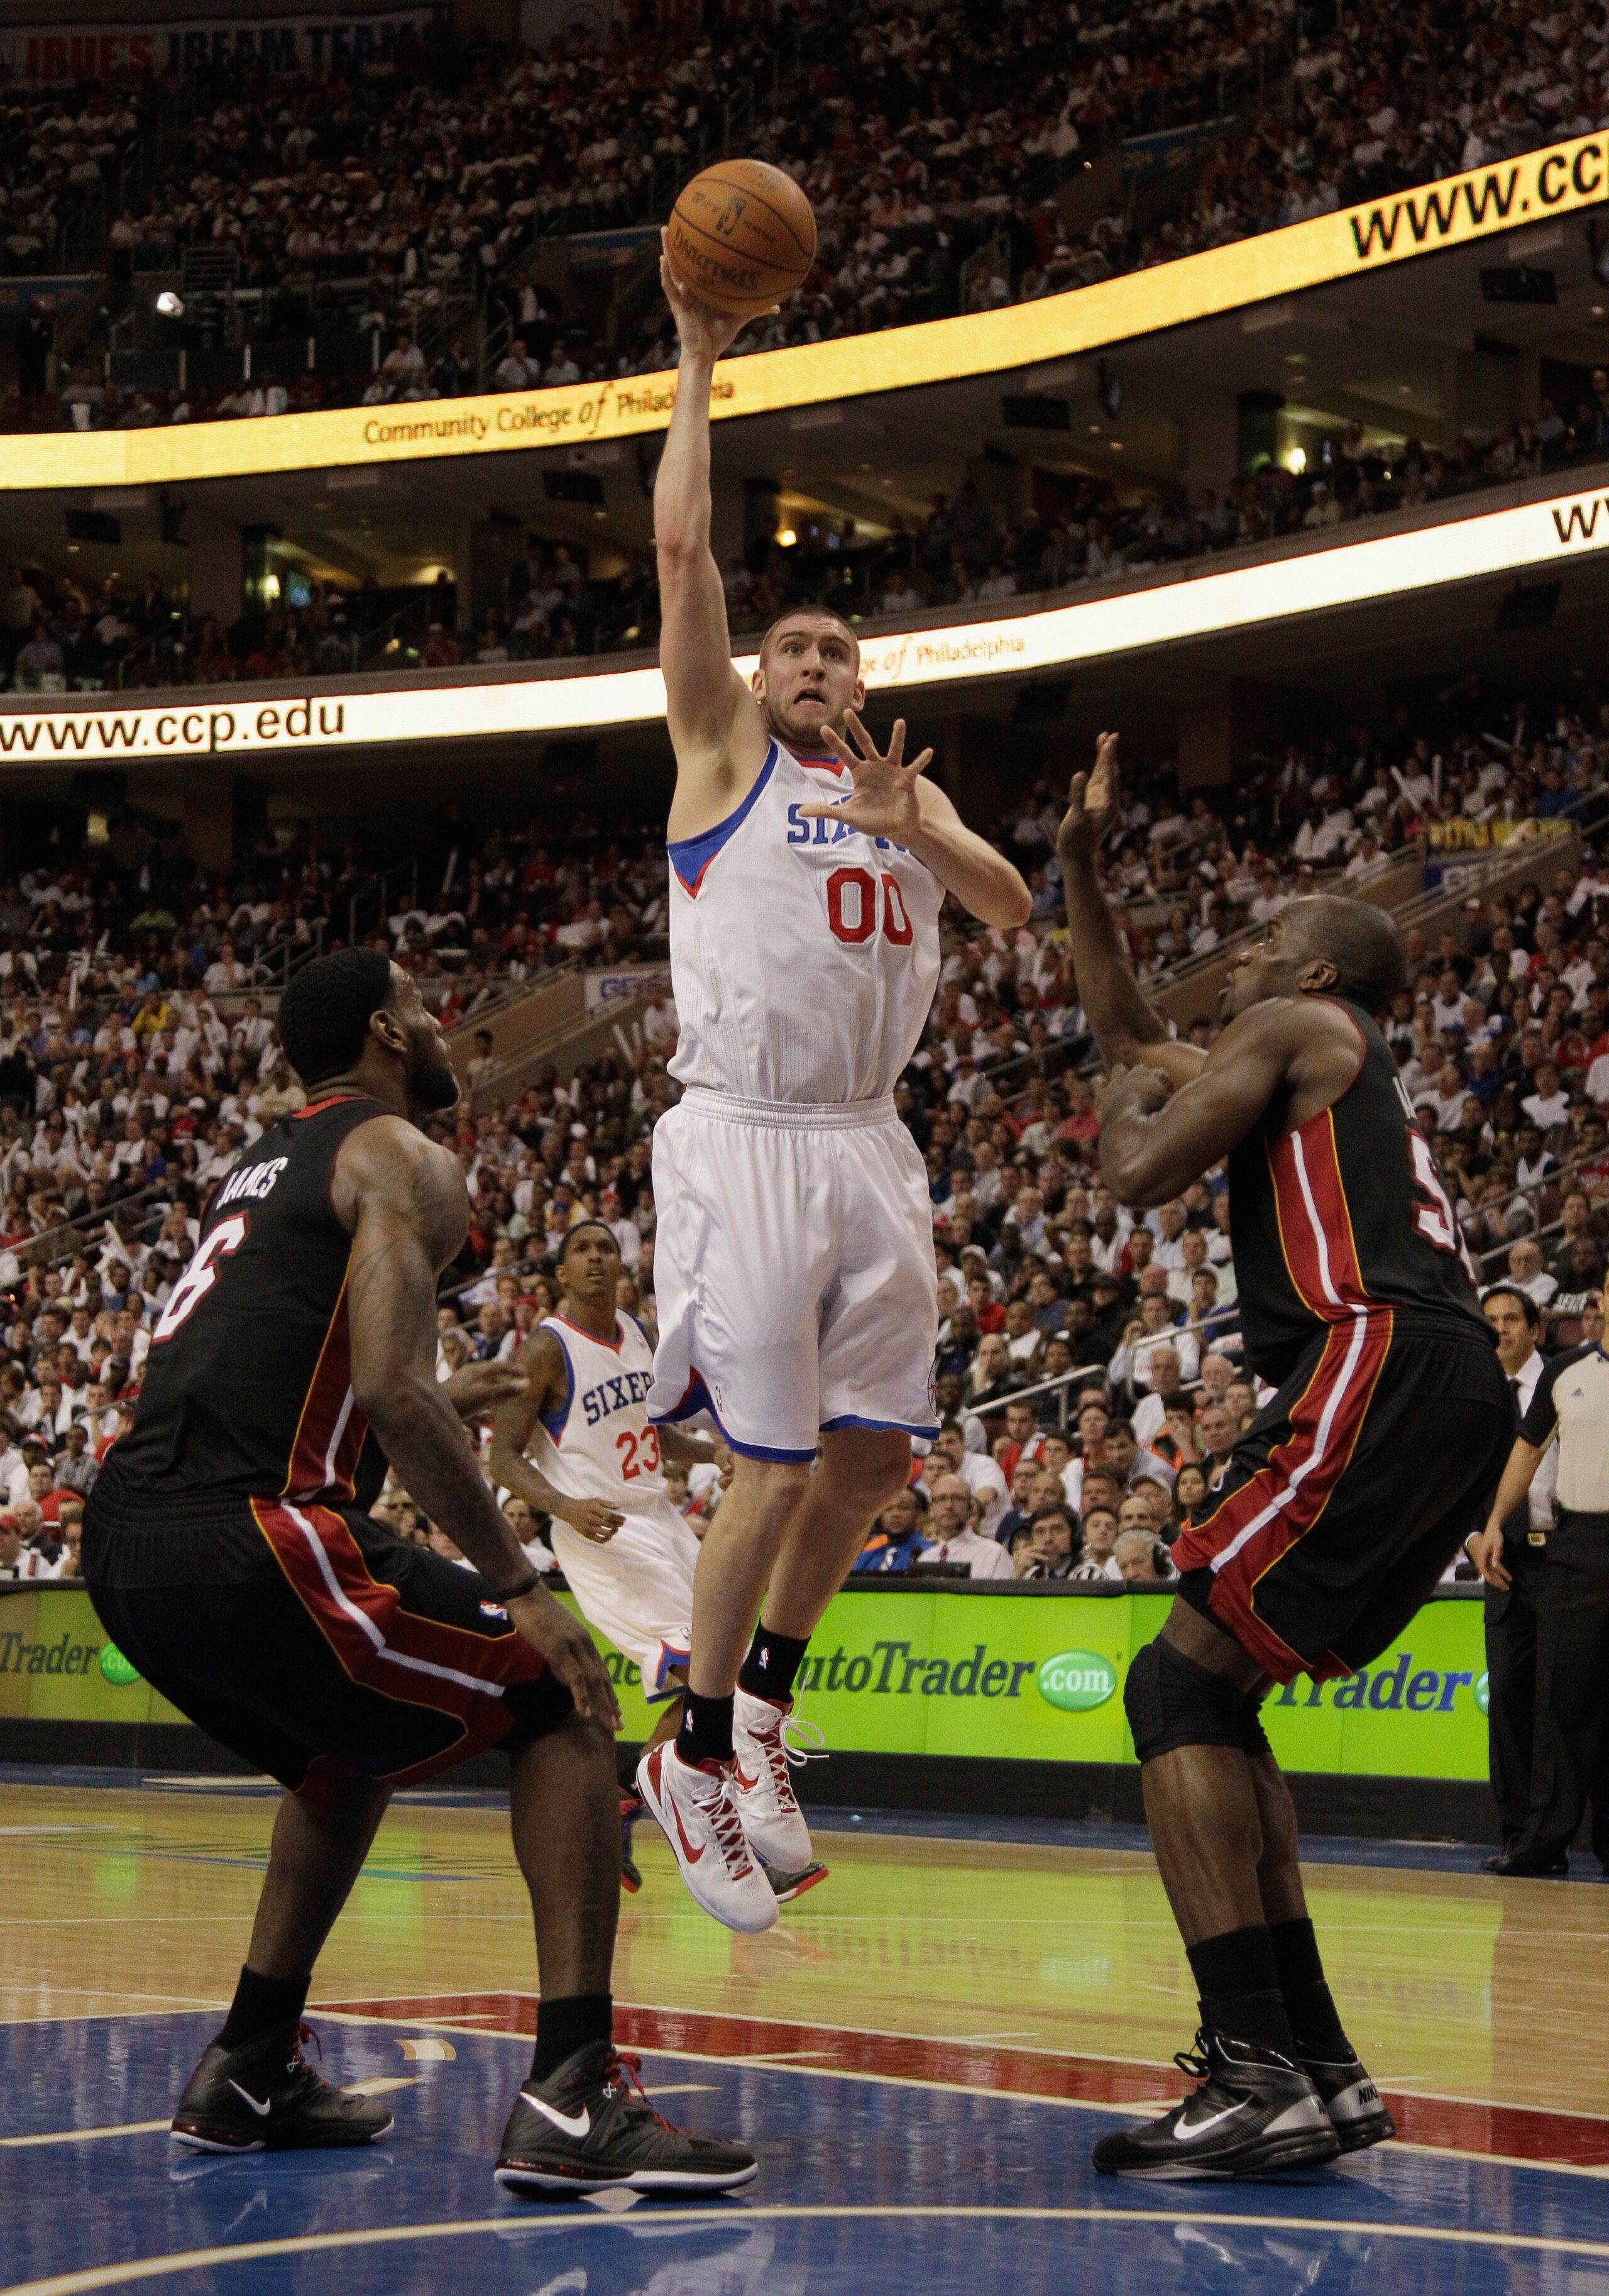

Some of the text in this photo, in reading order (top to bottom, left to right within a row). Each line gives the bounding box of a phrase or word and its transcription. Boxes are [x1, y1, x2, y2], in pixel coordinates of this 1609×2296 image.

[364, 411, 488, 444] Community
[497, 406, 571, 434] College
[579, 380, 615, 434] of
[916, 634, 1026, 665] Philadelphia
[0, 697, 345, 753] www.ccp.edu
[825, 865, 914, 946] 00
[216, 1156, 288, 1210] JAMES
[149, 1210, 250, 1345] 6
[616, 1423, 660, 1481] 23
[792, 1641, 1036, 1698] utoTrader
